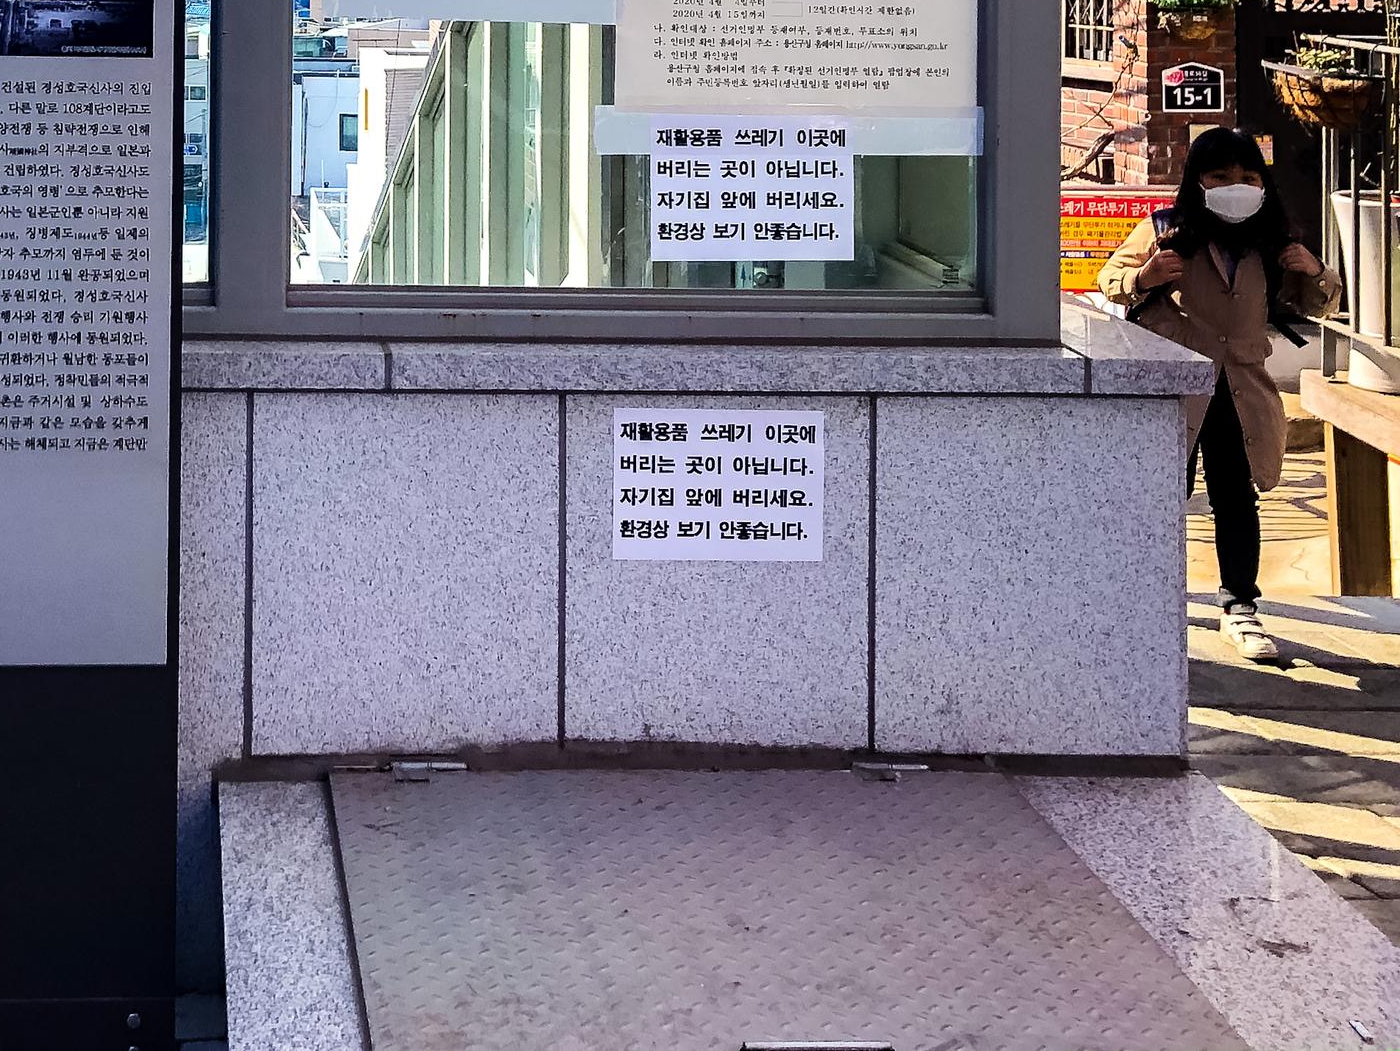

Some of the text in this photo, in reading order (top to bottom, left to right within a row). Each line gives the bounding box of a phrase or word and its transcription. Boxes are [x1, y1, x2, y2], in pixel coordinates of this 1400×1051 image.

[1172, 87, 1212, 106] 15-1
[656, 128, 845, 147] 재활용품 쓰레기 이곳에
[657, 159, 843, 178] 버리는 곳이 아닙니다.
[657, 190, 844, 209] 자기집 앞에 버리세요.
[1086, 201, 1128, 217] 무단투기
[1130, 202, 1151, 217] 금지
[657, 222, 838, 240] 환경상 보기 안좋습니다.
[619, 422, 816, 444] 재활용품 쓰레기 이곳에
[620, 454, 813, 476] 버리는 곳이 아닙니다.
[619, 486, 812, 508] 자기집 앞에 버리세요.
[619, 519, 807, 540] 환경상 보기 안좋습니다.
